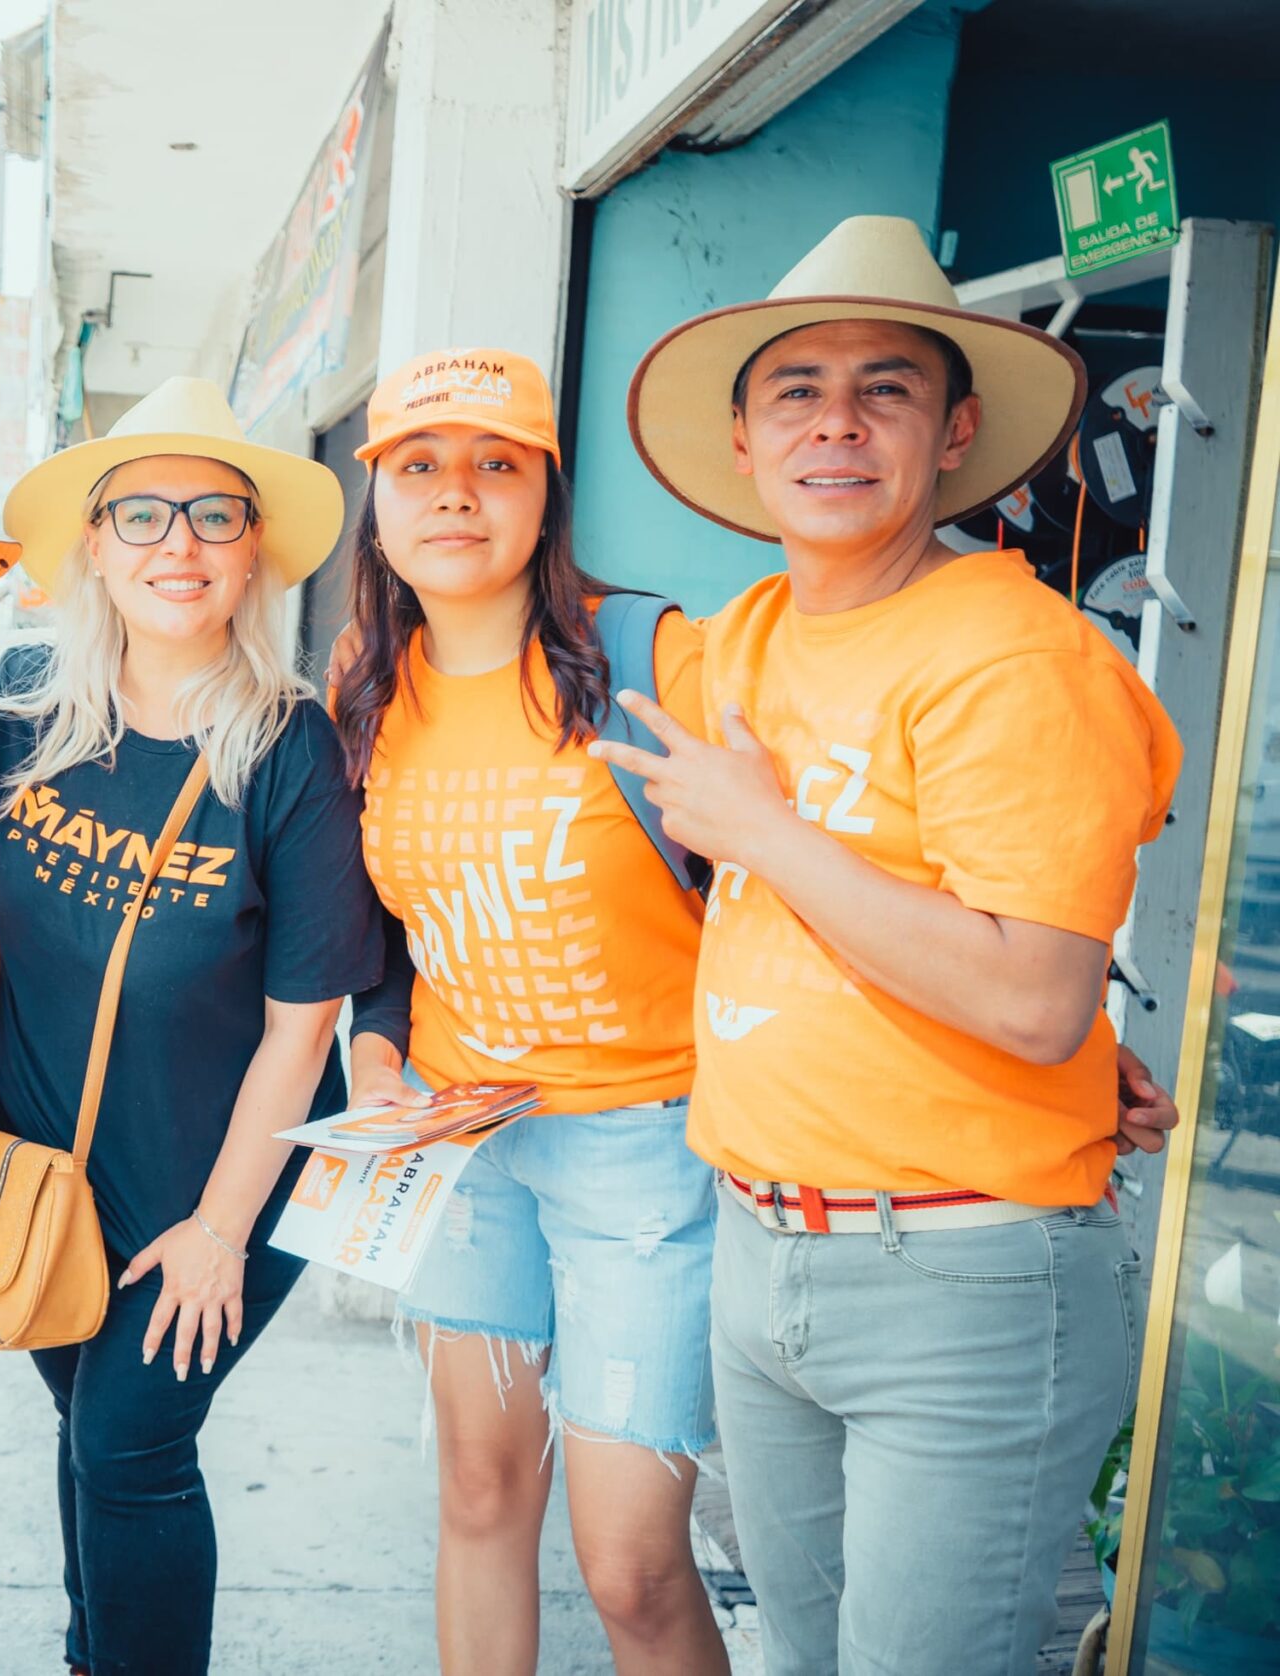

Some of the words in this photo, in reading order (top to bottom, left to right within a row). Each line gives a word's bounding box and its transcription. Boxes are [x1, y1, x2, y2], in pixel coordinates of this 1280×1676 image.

[1072, 227, 1170, 267] EMERGENCIA
[1079, 223, 1131, 249] SALIDA
[1135, 212, 1158, 230] DE
[412, 359, 505, 383] ABRAHAM
[405, 392, 450, 411] PRESIDENTE
[10, 784, 236, 887] MÁYNEZ
[6, 828, 210, 908] PRESIDENTE
[34, 865, 155, 919] MÉXICO
[358, 1153, 378, 1185] SIDENTE
[334, 1153, 405, 1267] ALAZAR
[366, 1152, 424, 1263] ABRAHAM
